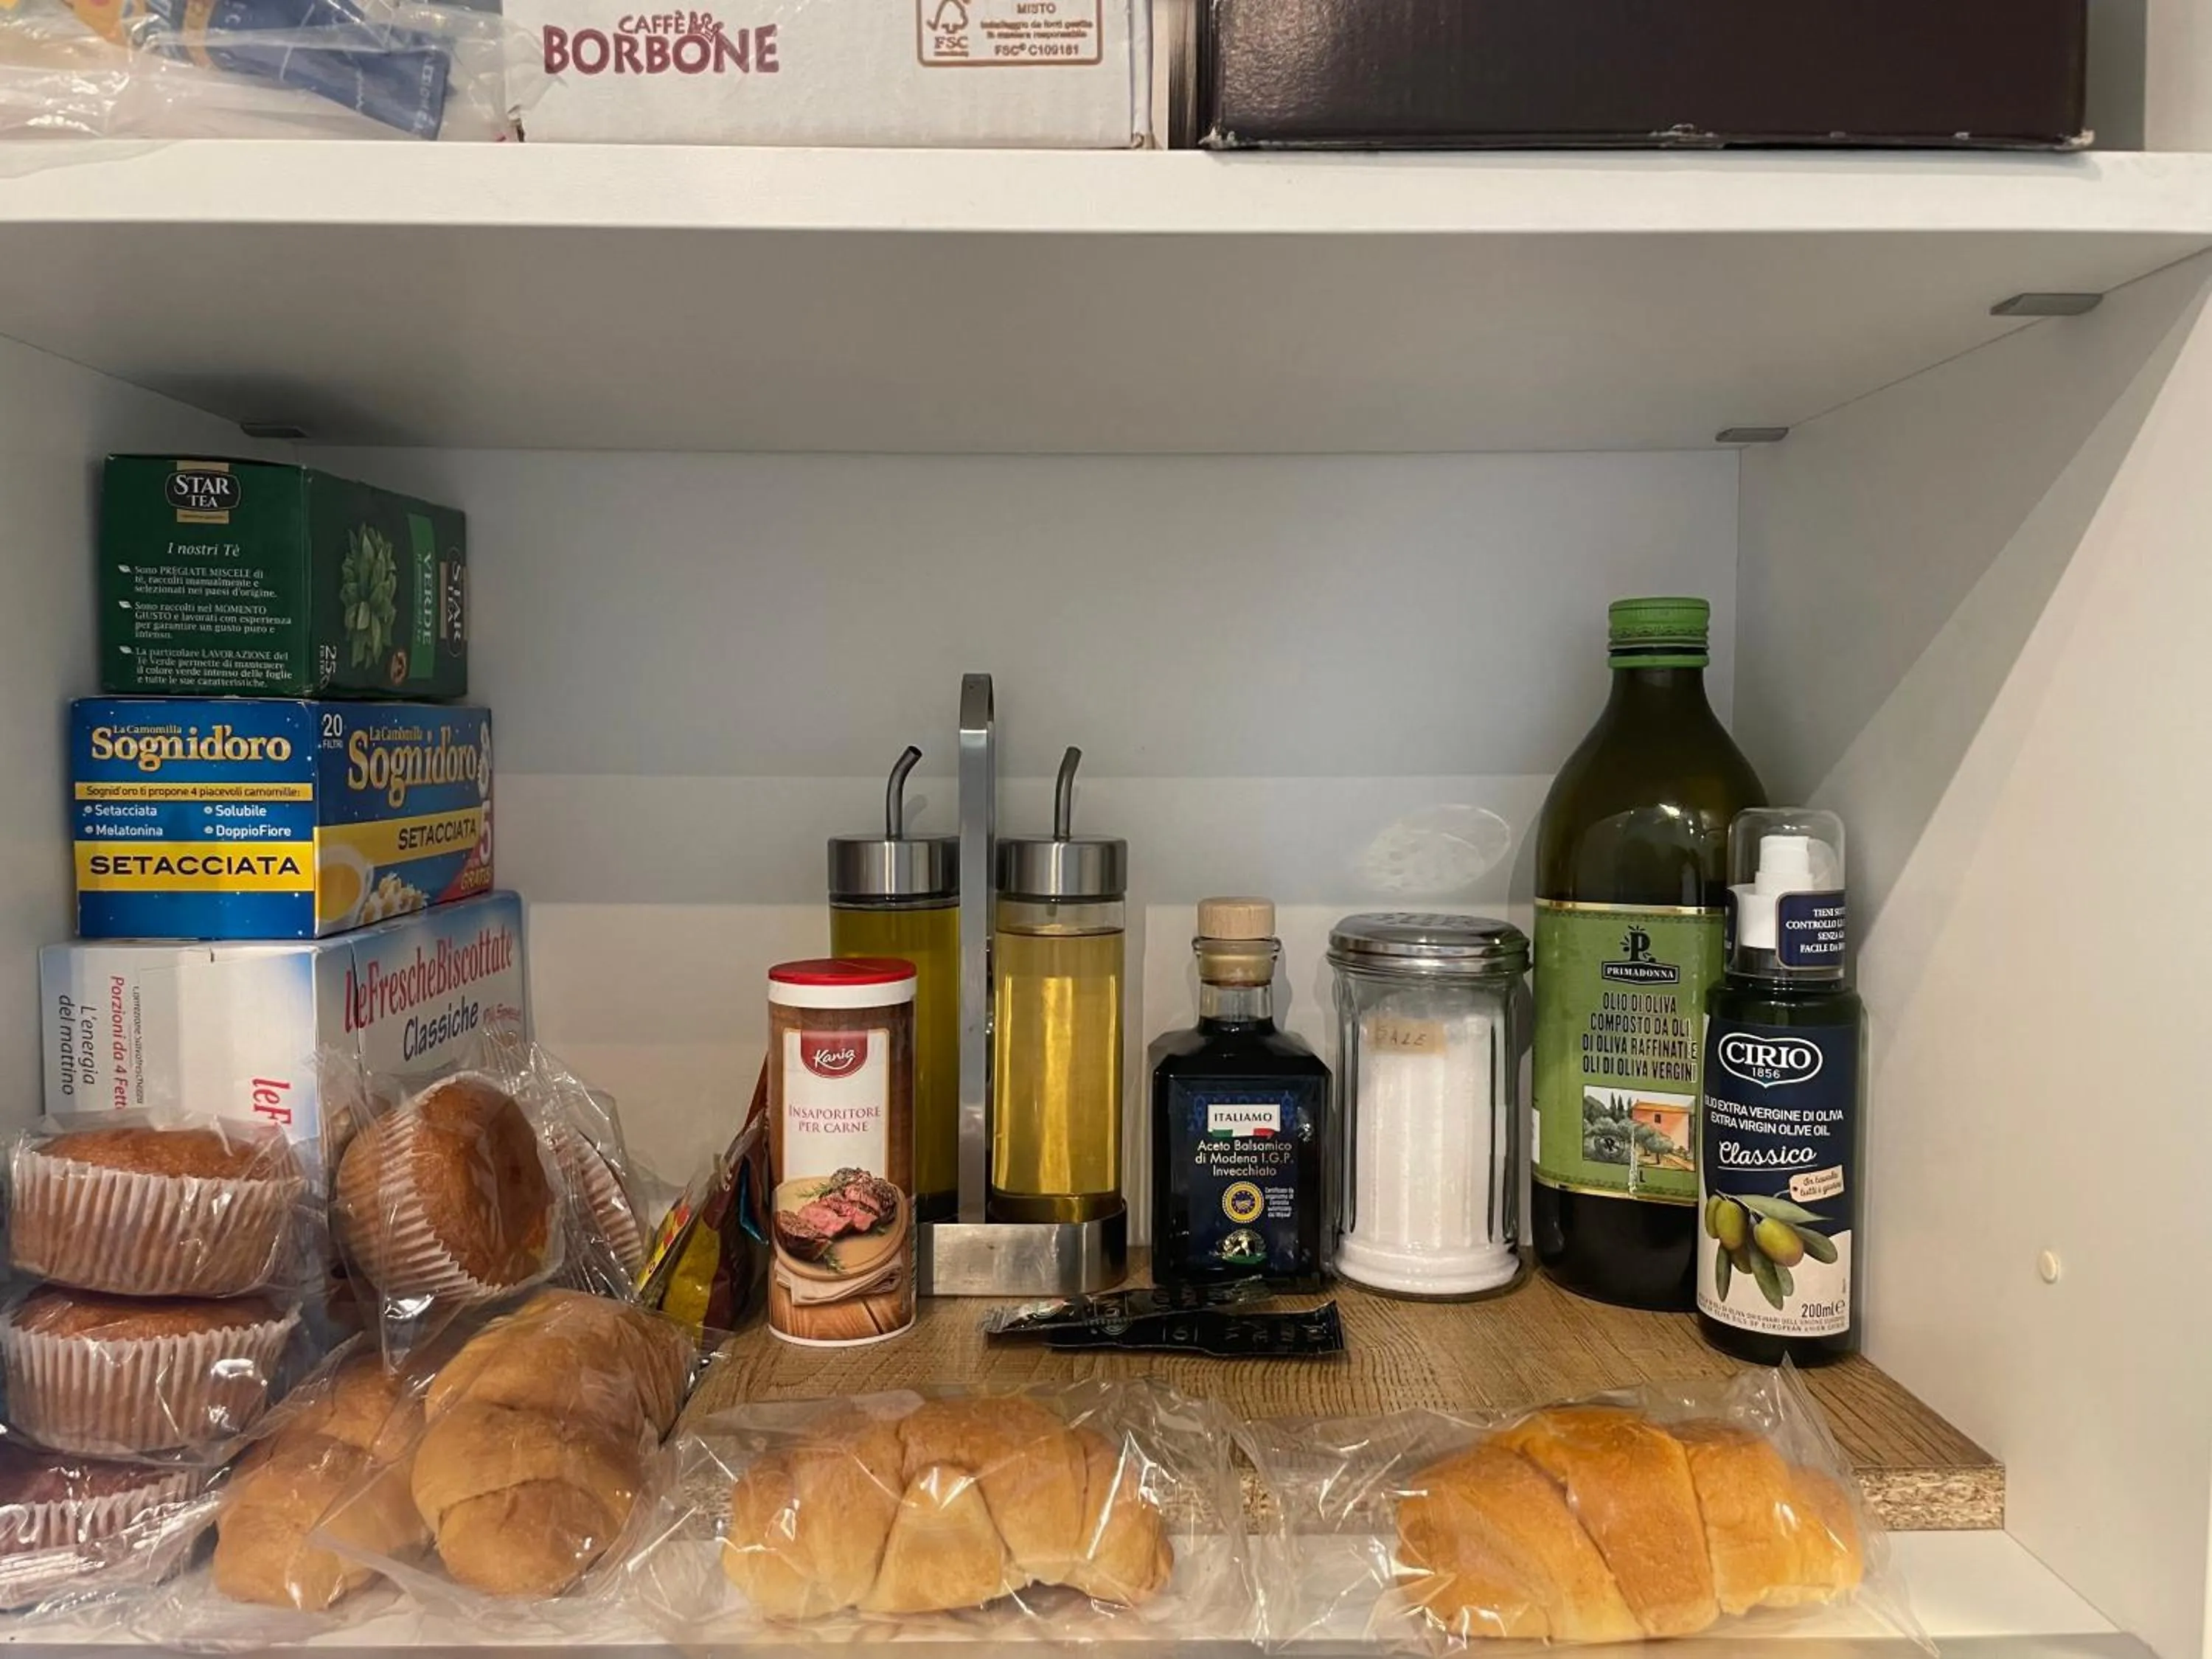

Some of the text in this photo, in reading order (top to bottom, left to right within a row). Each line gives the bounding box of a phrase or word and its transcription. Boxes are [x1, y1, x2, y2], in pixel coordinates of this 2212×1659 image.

[1017, 4, 1057, 14] MISTO
[618, 10, 685, 35] CAFFÈ
[543, 24, 779, 74] BORBONE
[934, 37, 969, 49] FSC
[174, 475, 230, 495] STAR
[187, 495, 218, 507] TEA
[167, 542, 240, 557] I nostri Tè
[160, 567, 206, 577] PREGIATE
[209, 568, 251, 578] MISCELE
[254, 570, 263, 579] di
[135, 584, 185, 594] selezionati
[185, 578, 251, 587] manualmente
[422, 552, 434, 644] VERDE
[135, 602, 268, 615] Sono raccolti nel MOMENTO
[135, 612, 171, 620] GIUSTO
[181, 613, 218, 623] lavorati
[221, 615, 237, 623] con
[240, 616, 292, 625] esperienza
[135, 622, 151, 630] per
[153, 622, 198, 632] garantire
[200, 624, 212, 632] un
[215, 625, 242, 633] gusto
[244, 626, 267, 635] puro
[136, 647, 288, 661] La particolare LAVORAZIONE del
[223, 659, 234, 669] di
[145, 667, 174, 675] colore
[175, 667, 201, 677] verde
[204, 668, 237, 678] intenso
[240, 669, 263, 679] delle
[265, 670, 293, 680] foglie
[114, 726, 182, 734] La Camomilla
[323, 714, 343, 737] 20
[322, 740, 343, 749] FILTRI
[148, 788, 189, 799] propone
[190, 787, 197, 796] 4
[199, 787, 242, 799] piacevoli
[95, 805, 266, 816] Setacciata Solubile
[96, 825, 291, 839] Melatonina DoppioFiore
[398, 818, 476, 850] SETACCIATA
[89, 856, 301, 876] SETACCIATA
[1814, 908, 1834, 917] TIENI
[1786, 921, 1837, 930] CONTROLLO
[1800, 943, 1829, 953] FACILE
[1607, 967, 1674, 978] PRIMADONNA
[110, 975, 125, 1036] Porzioni
[1603, 992, 1677, 1015] OLIO DI OLIVA
[403, 995, 479, 1062] Classiche
[1590, 1012, 1690, 1037] COMPOSTO DA OLI
[59, 995, 77, 1095] del mattino
[77, 1004, 100, 1085] L'energia
[113, 1037, 127, 1060] da
[1582, 1034, 1593, 1052] DI
[1596, 1035, 1627, 1054] OLIVA
[1631, 1038, 1688, 1059] RAFFINATI
[813, 1048, 856, 1068] Kania
[1727, 1042, 1812, 1068] CIRIO
[116, 1066, 128, 1074] 4
[1583, 1055, 1599, 1074] OLI
[1603, 1057, 1614, 1074] DI
[1618, 1058, 1647, 1077] OLIVA
[1753, 1068, 1781, 1078] 1856
[789, 1105, 881, 1119] INSAPORITORE
[1717, 1099, 1748, 1116] EXTRA
[1749, 1105, 1801, 1121] VERGINE
[1804, 1110, 1815, 1121] DI
[1816, 1110, 1843, 1121] OLIVA
[1214, 1113, 1272, 1122] ITALIAMO
[1711, 1112, 1831, 1136] EXTRA VIRGIN OLIVE OIL
[799, 1121, 869, 1133] PER CARNE
[1197, 1140, 1293, 1151] Aceto Balsamico
[1195, 1152, 1294, 1164] di Modena I.G.P.
[1719, 1140, 1817, 1165] Classico
[1213, 1164, 1277, 1177] Invecchiato
